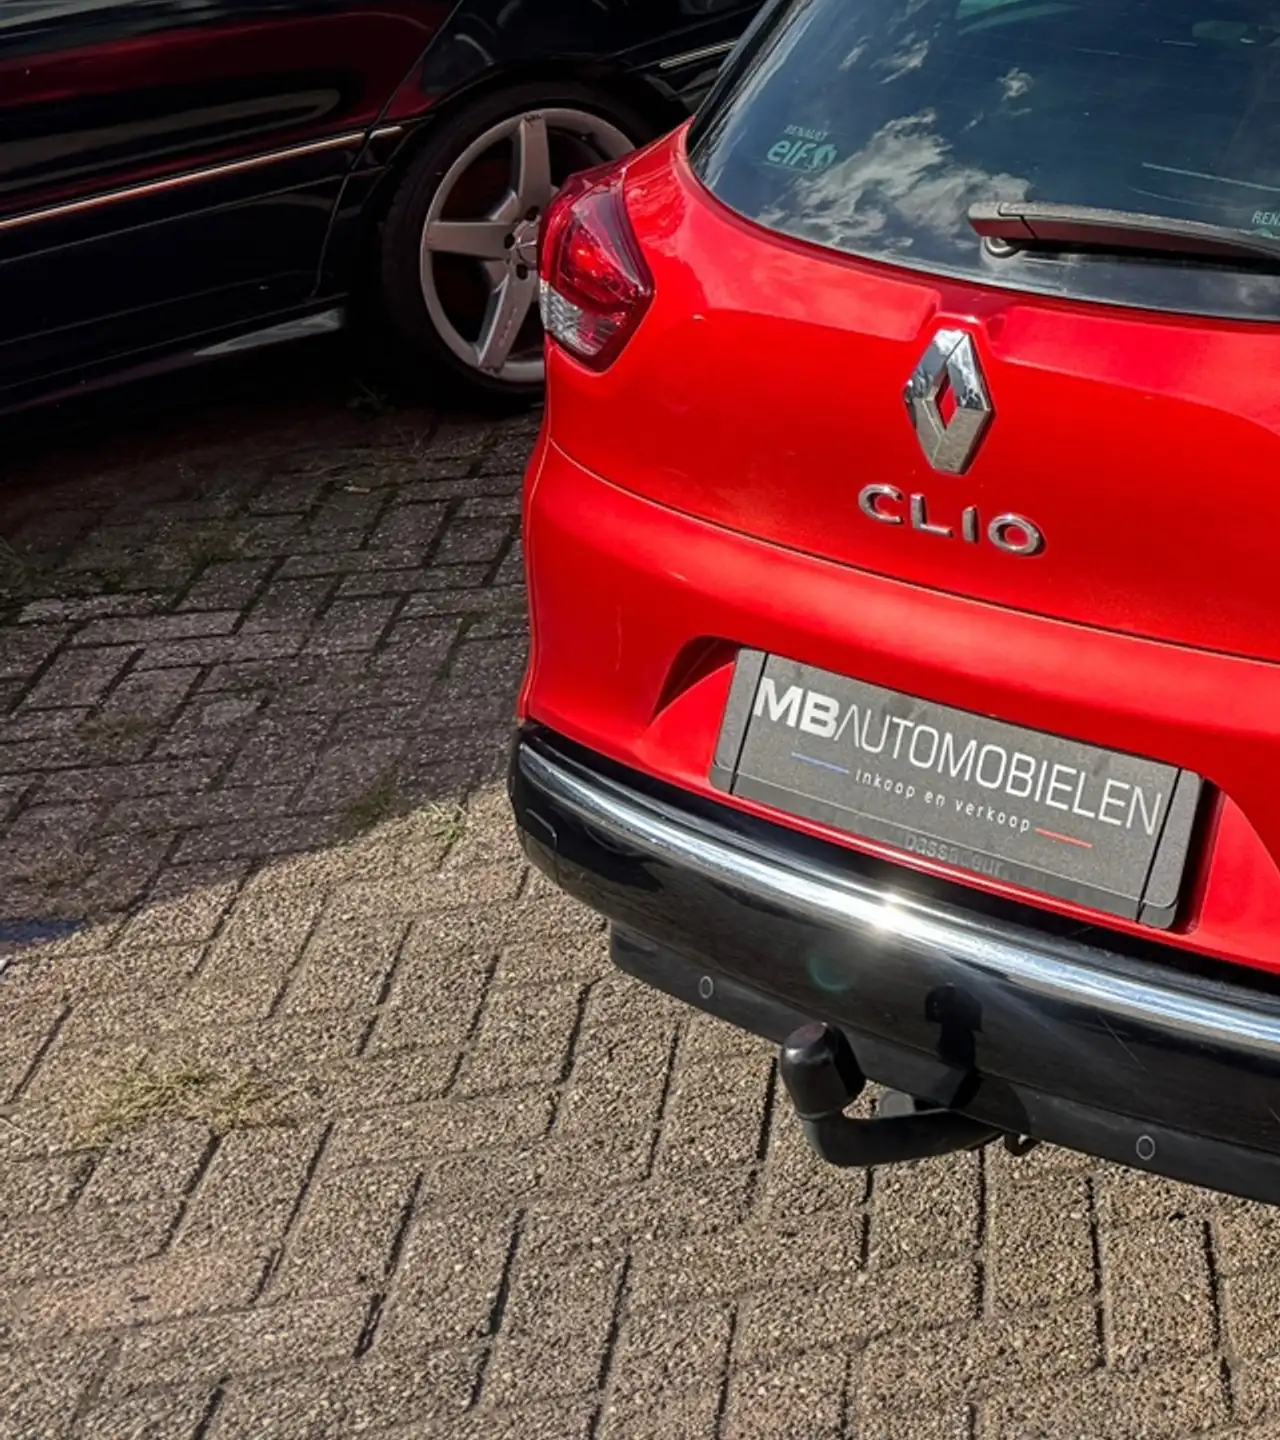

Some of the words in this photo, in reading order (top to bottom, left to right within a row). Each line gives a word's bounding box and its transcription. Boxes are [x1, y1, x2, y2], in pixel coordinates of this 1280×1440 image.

[858, 483, 1044, 556] CLIO
[753, 677, 1162, 836] MBAUTOMOBIELEN
[924, 791, 946, 808] en
[955, 799, 1030, 833] verkoop
